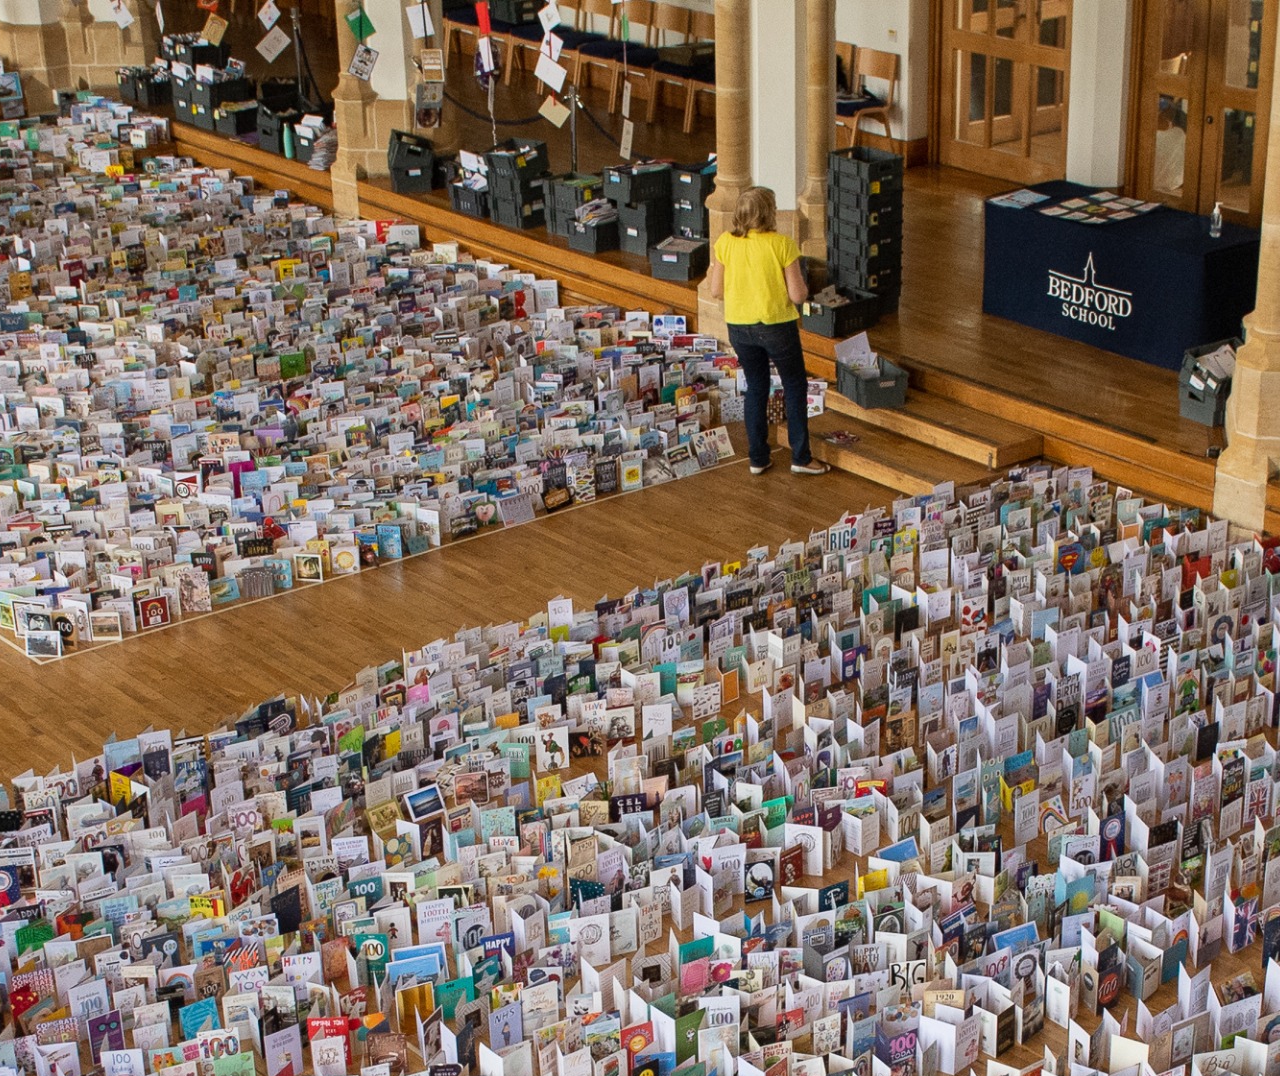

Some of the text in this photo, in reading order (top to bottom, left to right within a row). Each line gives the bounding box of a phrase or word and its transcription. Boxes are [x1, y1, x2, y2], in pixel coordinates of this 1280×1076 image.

[401, 228, 417, 238] 100
[1047, 276, 1133, 318] BEDFORD
[1061, 302, 1117, 332] SCHOOL
[144, 442, 166, 453] HAPPY
[523, 483, 541, 497] 100
[830, 529, 852, 553] BIG
[247, 545, 270, 556] HAPPY
[147, 607, 164, 618] 100
[56, 621, 72, 633] 100
[661, 633, 682, 651] 100
[1136, 652, 1152, 669] 100
[577, 675, 591, 687] 100
[344, 692, 359, 704] 100
[616, 798, 642, 808] CEL
[233, 811, 257, 828] 100
[355, 882, 376, 895] 100
[363, 942, 384, 957] 100
[485, 939, 511, 953] HAPPY
[891, 962, 926, 989] BIG
[81, 996, 103, 1012] 100
[934, 993, 955, 1002] 1920
[495, 1010, 516, 1025] NHS
[710, 1013, 734, 1025] 100
[201, 1035, 239, 1059] 100
[889, 1034, 917, 1052] 100
[111, 1053, 133, 1066] 100
[891, 1049, 917, 1061] TODAY
